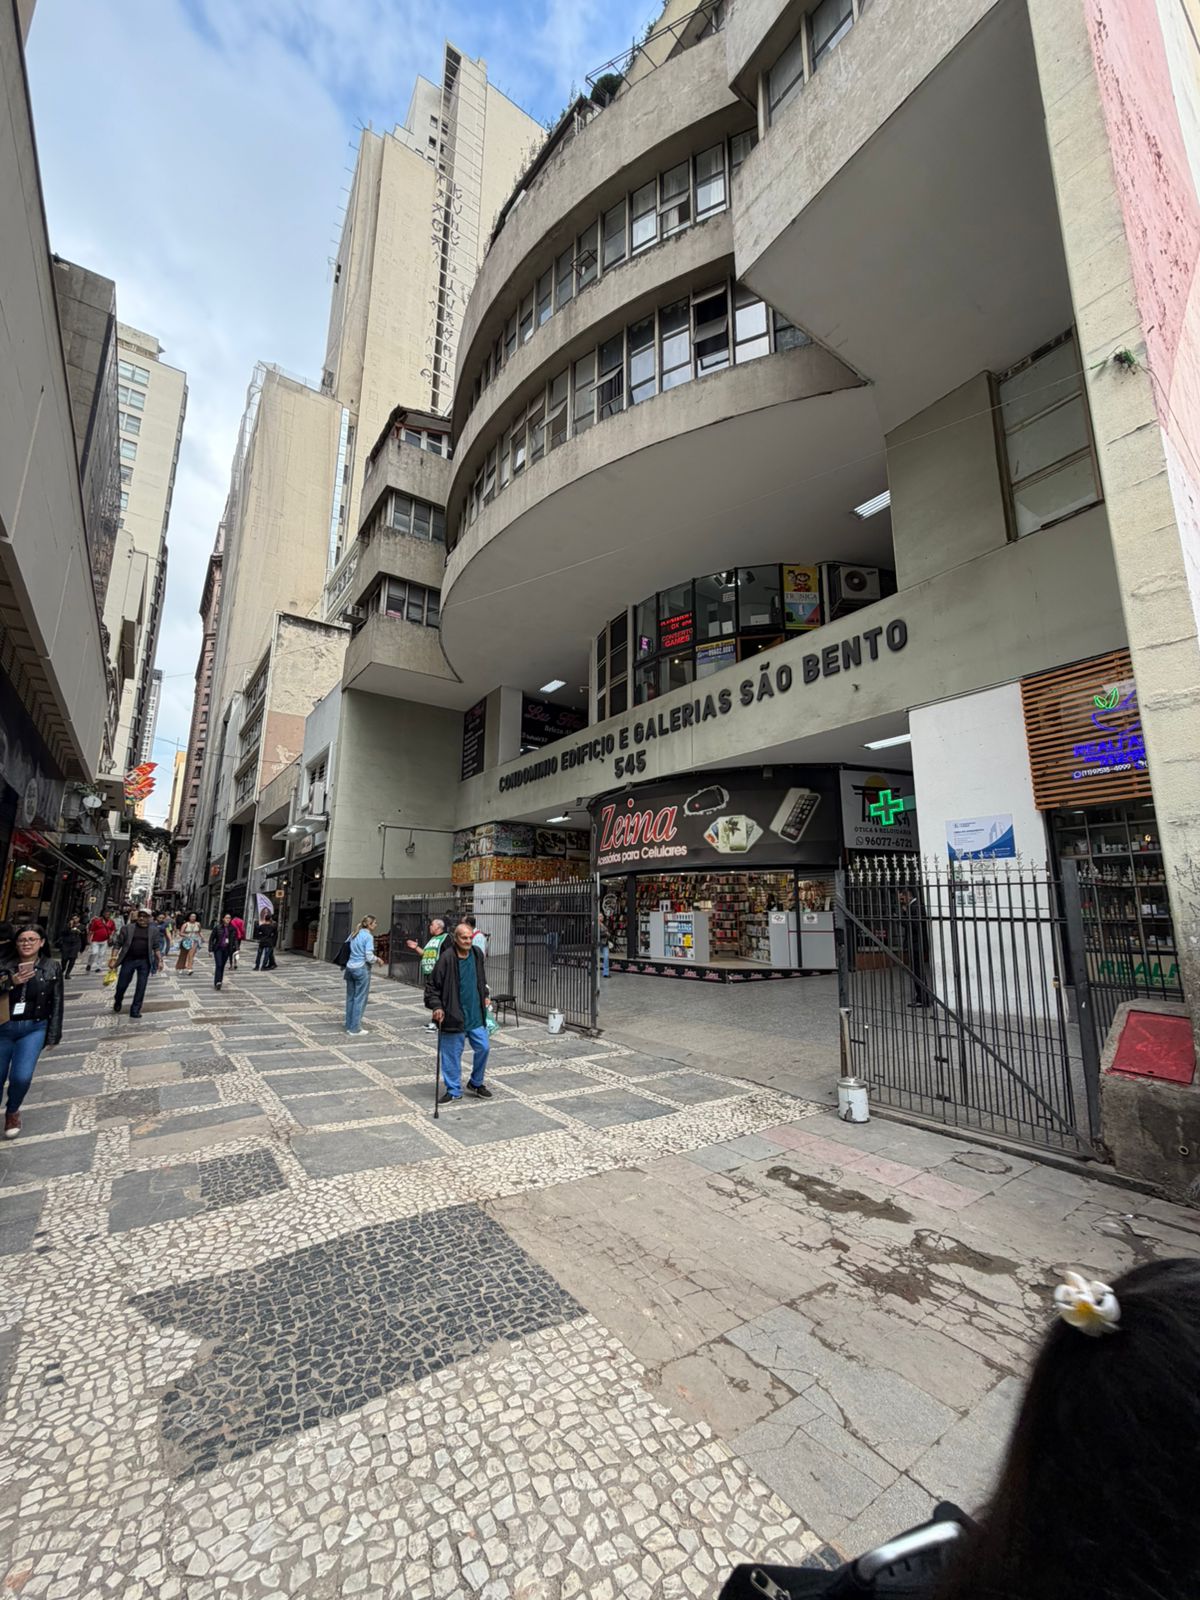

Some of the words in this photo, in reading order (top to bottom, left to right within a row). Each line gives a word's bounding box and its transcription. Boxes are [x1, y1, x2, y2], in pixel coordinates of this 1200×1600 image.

[499, 756, 558, 793] CONDOMINIO
[619, 726, 630, 749] E
[634, 688, 732, 744] GALERIAS
[739, 661, 793, 706] SÃO
[802, 618, 908, 685] BENTO
[614, 749, 647, 779] 545
[600, 798, 678, 851] Zeina
[622, 850, 640, 864] para
[641, 844, 688, 859] Celulares
[864, 836, 913, 848] 96077-6721
